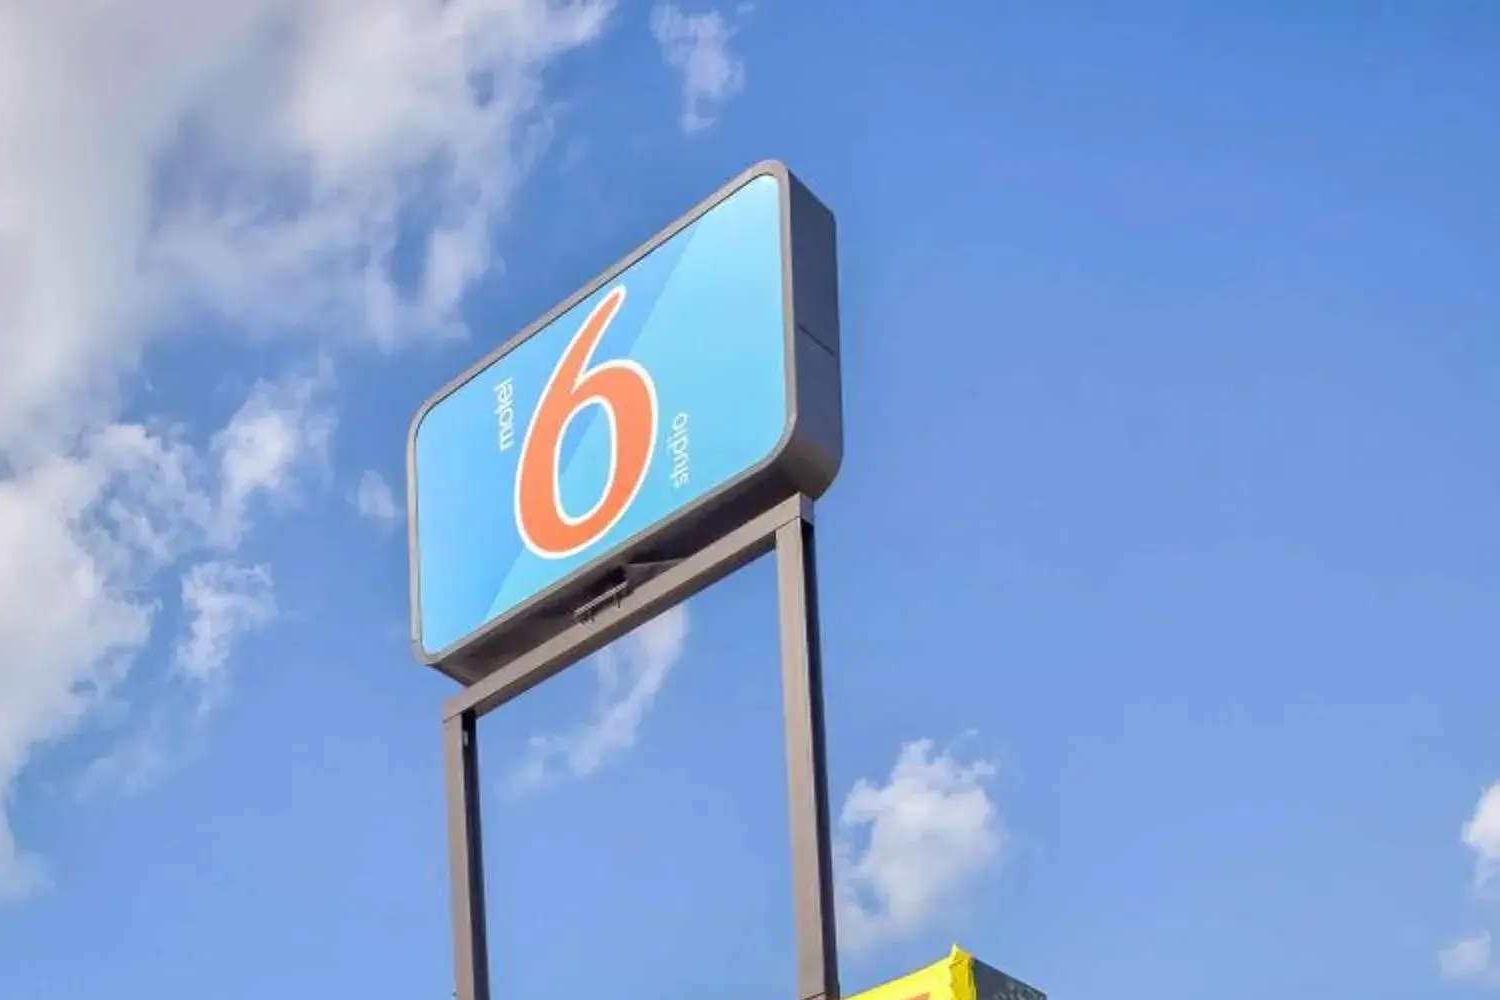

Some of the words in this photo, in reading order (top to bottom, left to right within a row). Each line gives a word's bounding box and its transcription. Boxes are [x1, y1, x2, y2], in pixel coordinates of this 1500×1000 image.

[493, 377, 514, 451] motel
[514, 284, 659, 559] 6
[667, 411, 689, 488] studio
